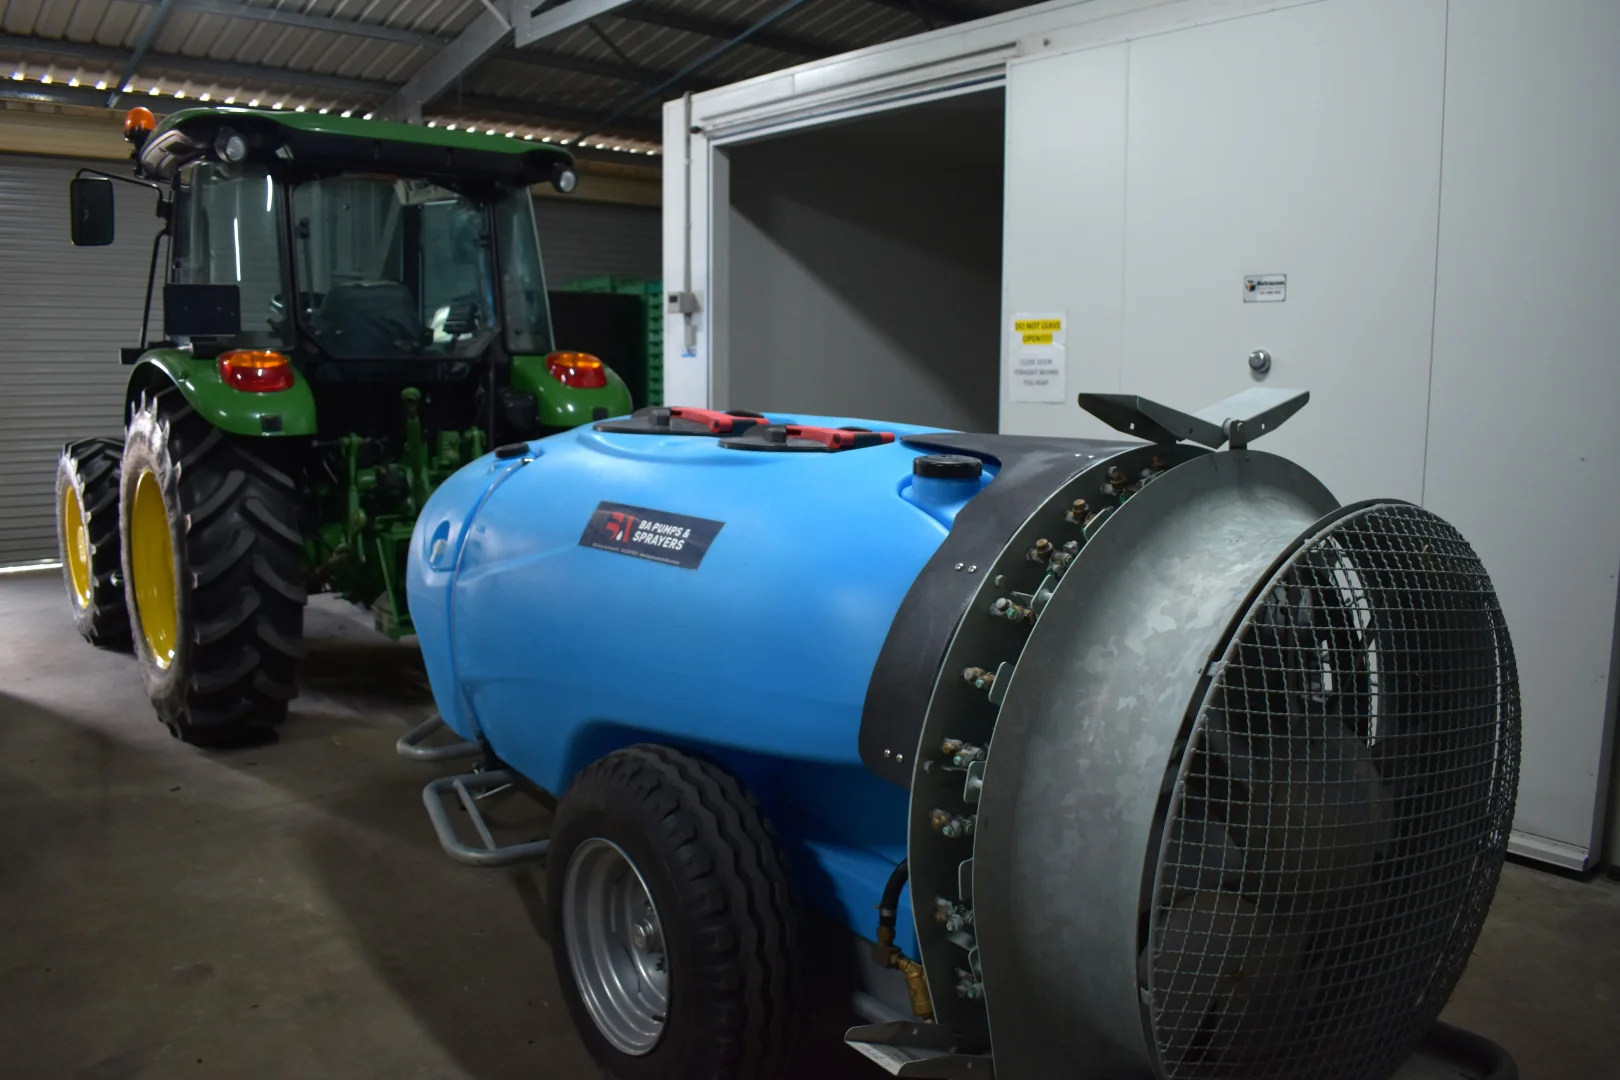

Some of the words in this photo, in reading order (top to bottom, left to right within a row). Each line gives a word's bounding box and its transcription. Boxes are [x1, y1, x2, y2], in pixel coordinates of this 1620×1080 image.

[1015, 322, 1025, 330] DO
[1026, 321, 1040, 330] NOT
[1041, 320, 1061, 329] LEAVE
[638, 520, 651, 531] BA
[652, 522, 683, 537] PUMPS
[682, 529, 691, 538] &
[632, 531, 685, 551] SPRAYERS
